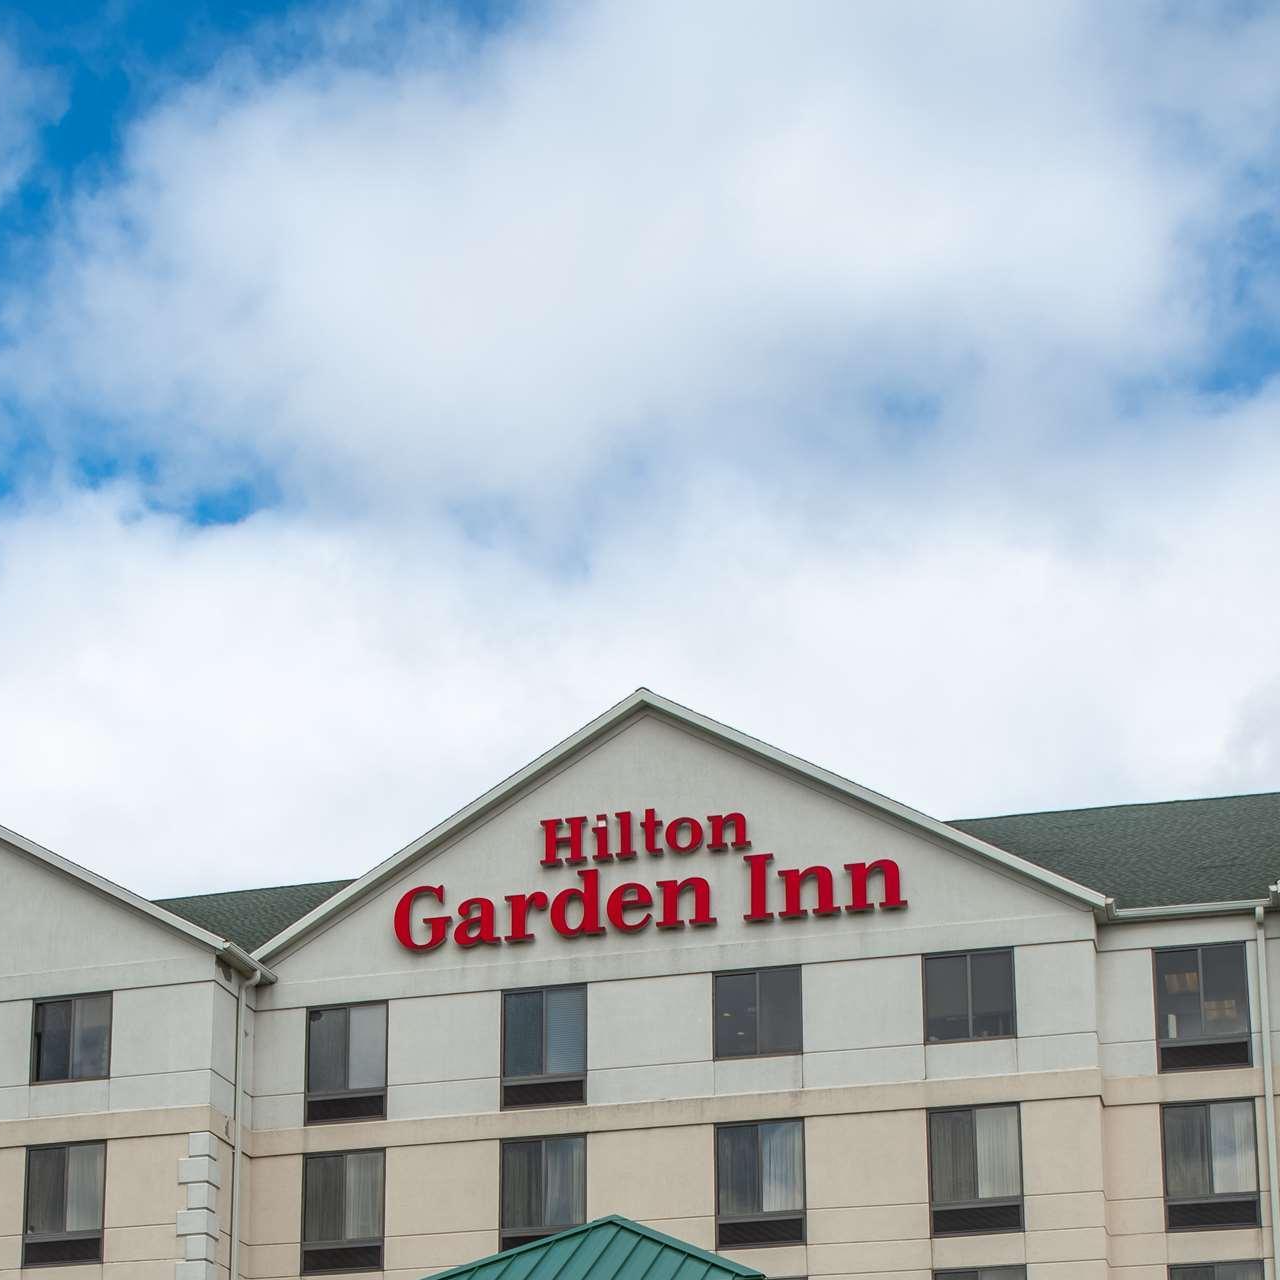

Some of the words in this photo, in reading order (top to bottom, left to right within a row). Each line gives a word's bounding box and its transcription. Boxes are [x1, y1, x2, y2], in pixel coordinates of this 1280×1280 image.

[540, 808, 752, 867] Hilton
[394, 869, 718, 951] Garden
[743, 853, 907, 921] Inn
